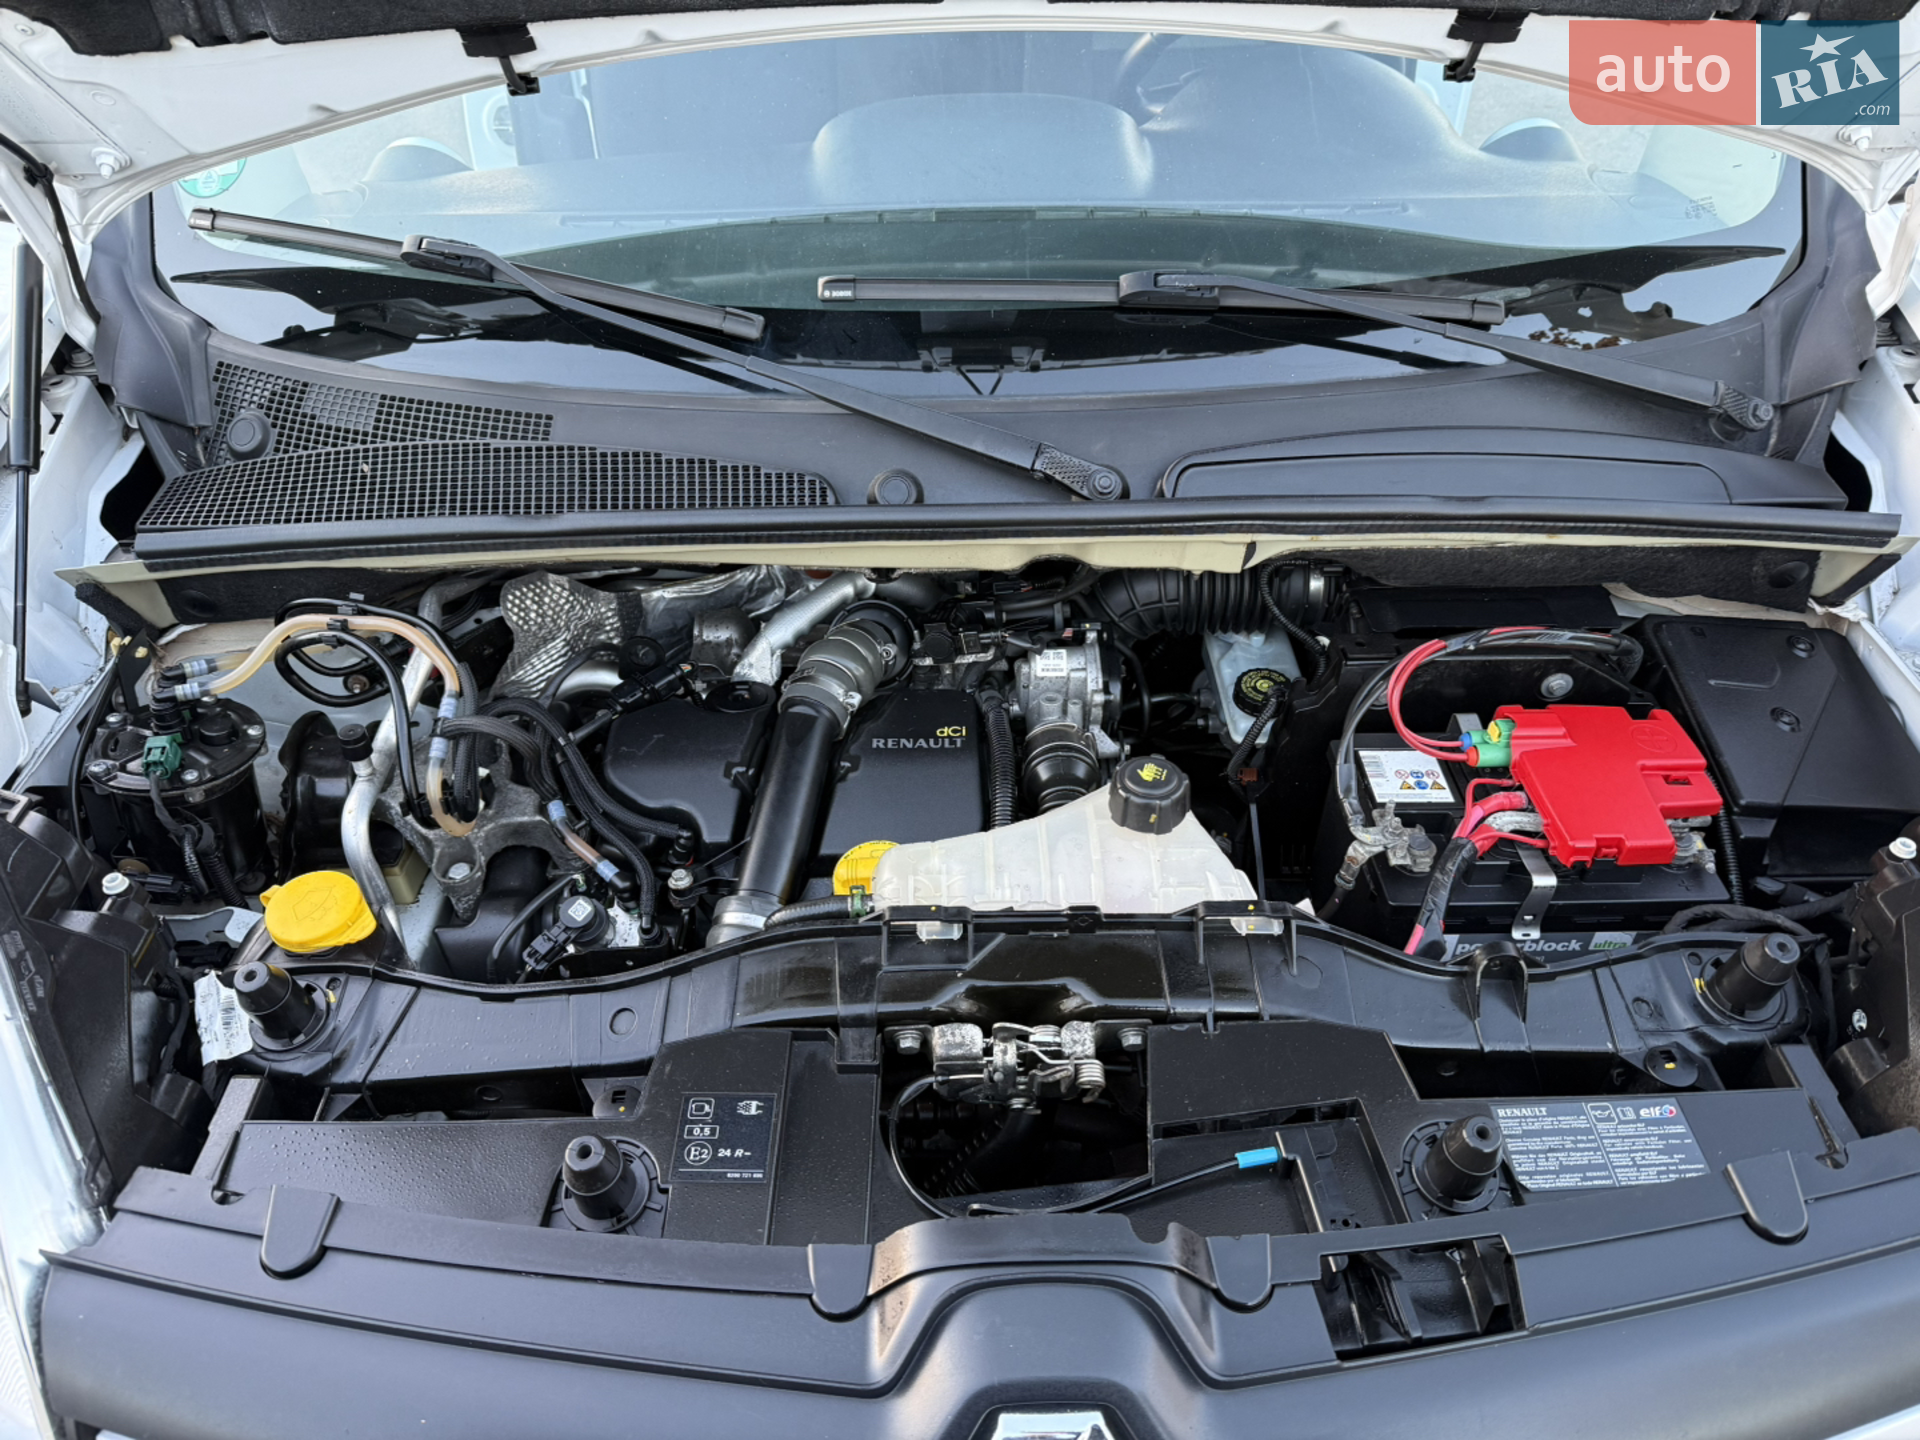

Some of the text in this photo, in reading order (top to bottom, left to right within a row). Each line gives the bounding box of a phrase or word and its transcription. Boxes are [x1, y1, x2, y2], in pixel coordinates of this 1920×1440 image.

[936, 726, 966, 737] dCi
[872, 738, 965, 748] RENAULT
[1593, 940, 1629, 949] ultra
[1497, 1107, 1547, 1117] RENAULT
[1639, 1106, 1662, 1117] elf
[692, 1127, 711, 1137] 0,5
[717, 1149, 731, 1157] 24
